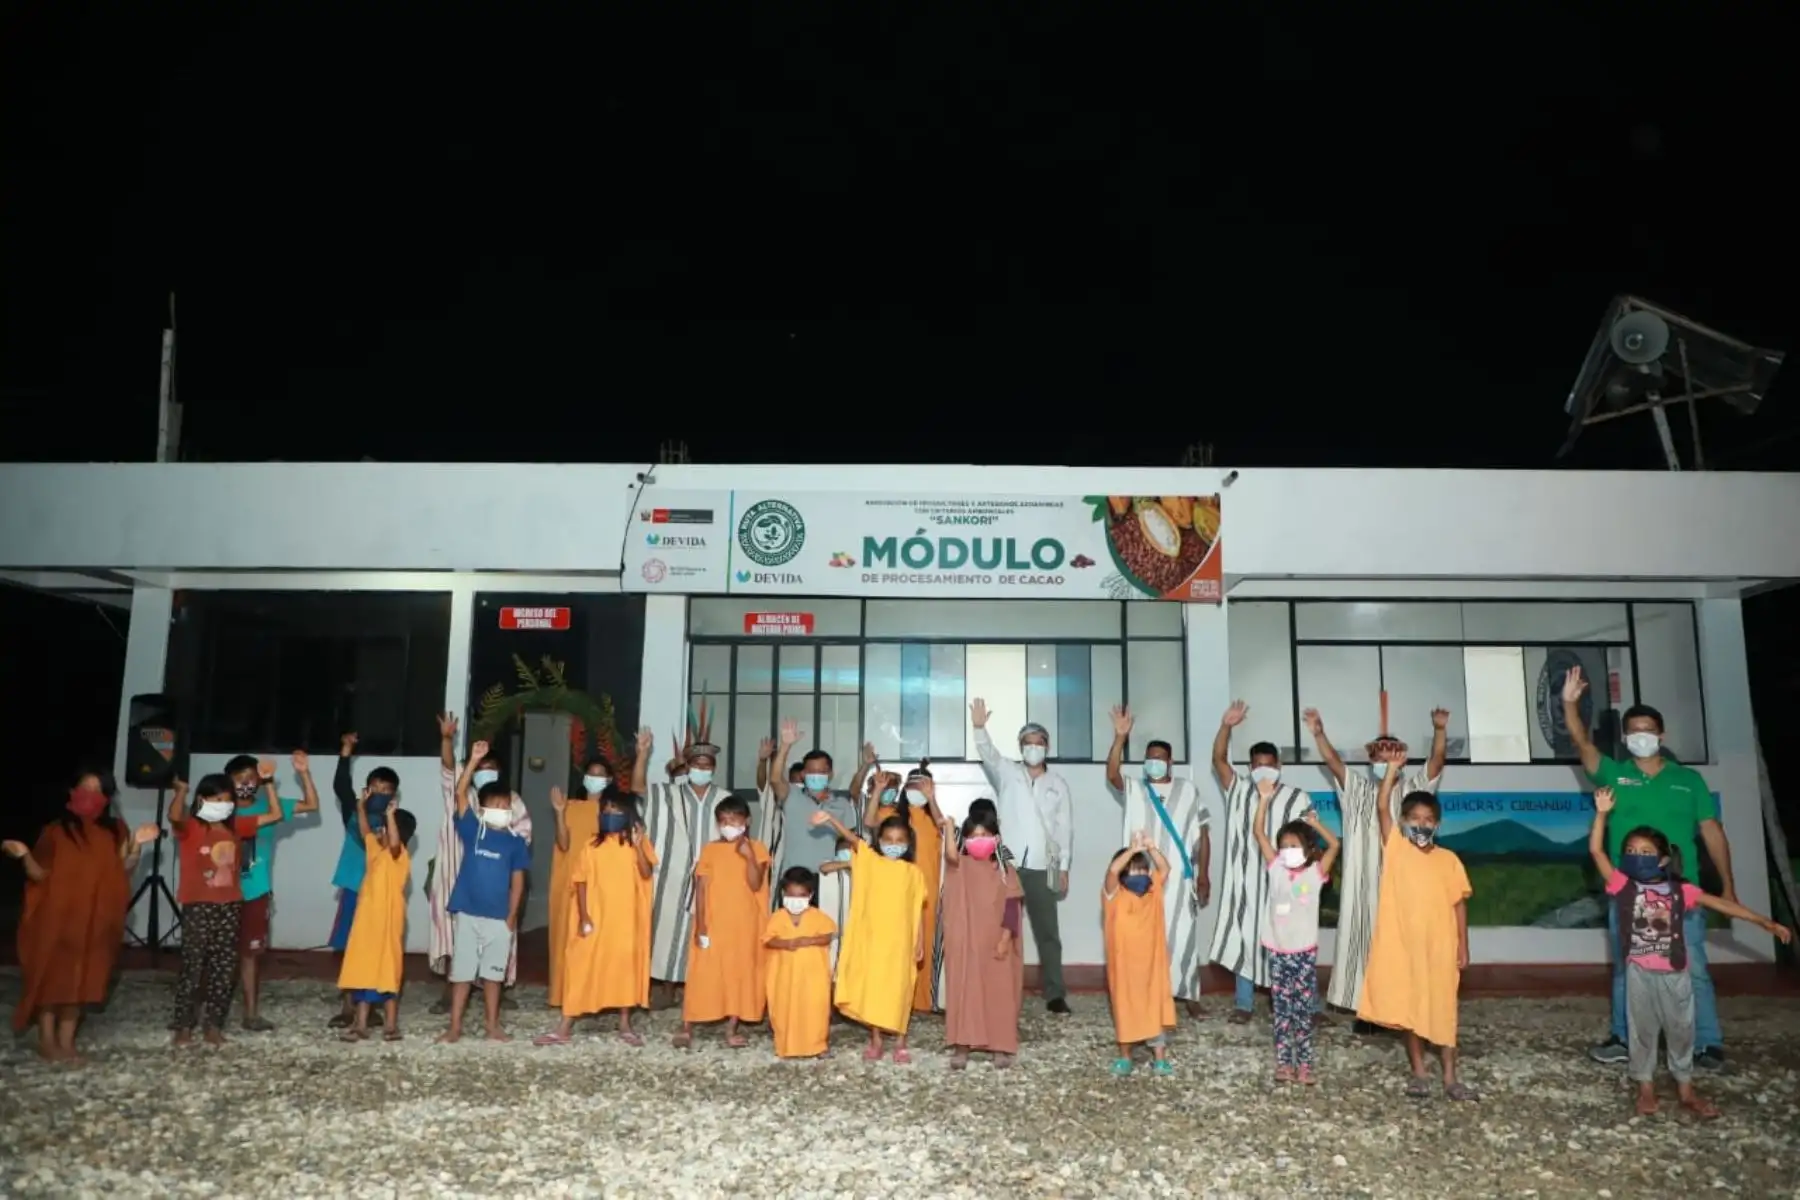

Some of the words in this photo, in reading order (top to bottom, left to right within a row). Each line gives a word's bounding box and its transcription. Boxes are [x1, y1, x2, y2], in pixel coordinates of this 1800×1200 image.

[662, 536, 707, 547] DEVIDA
[862, 527, 1066, 571] MÓDULO
[754, 572, 804, 585] DEVIDA
[861, 573, 880, 584] DE
[881, 573, 993, 586] PROCESAMIENTO
[998, 574, 1017, 585] DE
[1018, 574, 1066, 587] CACAO
[516, 618, 552, 629] PERSONAL
[791, 615, 800, 624] DE
[1444, 797, 1504, 812] CHACRAS
